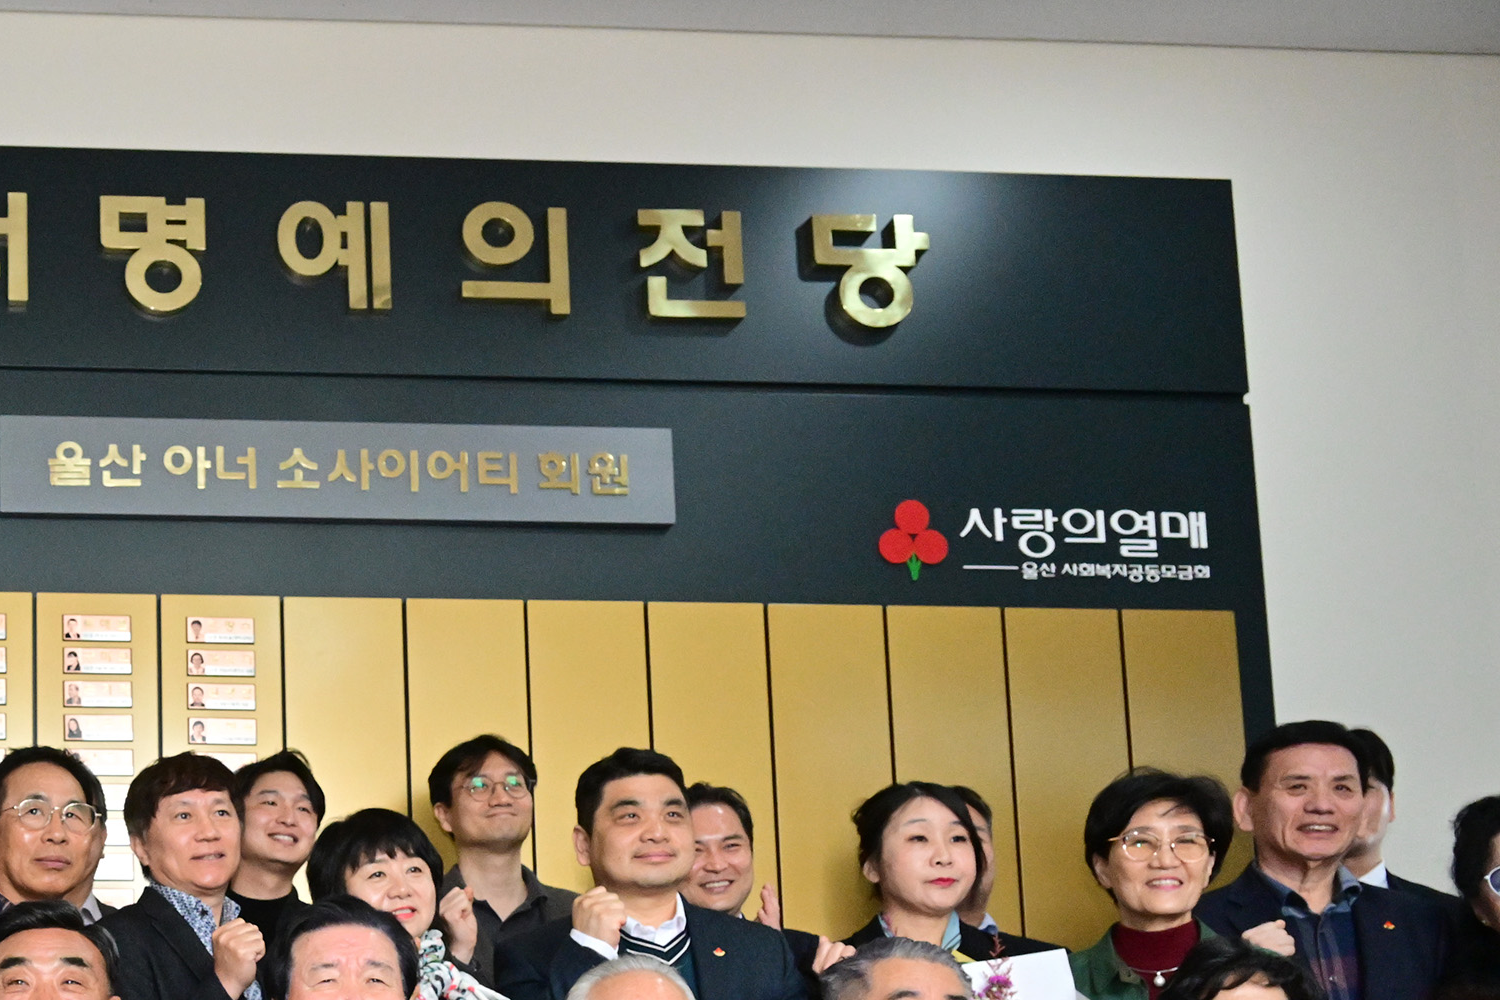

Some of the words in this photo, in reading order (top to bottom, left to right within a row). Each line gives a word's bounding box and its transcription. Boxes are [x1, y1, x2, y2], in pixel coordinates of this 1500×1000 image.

[47, 441, 146, 488] 울산
[164, 445, 258, 490] 아너
[277, 448, 520, 494] 소사이어티
[537, 452, 630, 496] 회원
[959, 507, 1208, 558] 사랑의열매
[1021, 562, 1057, 580] 울산
[1061, 562, 1211, 583] 사회복지공동모금회
